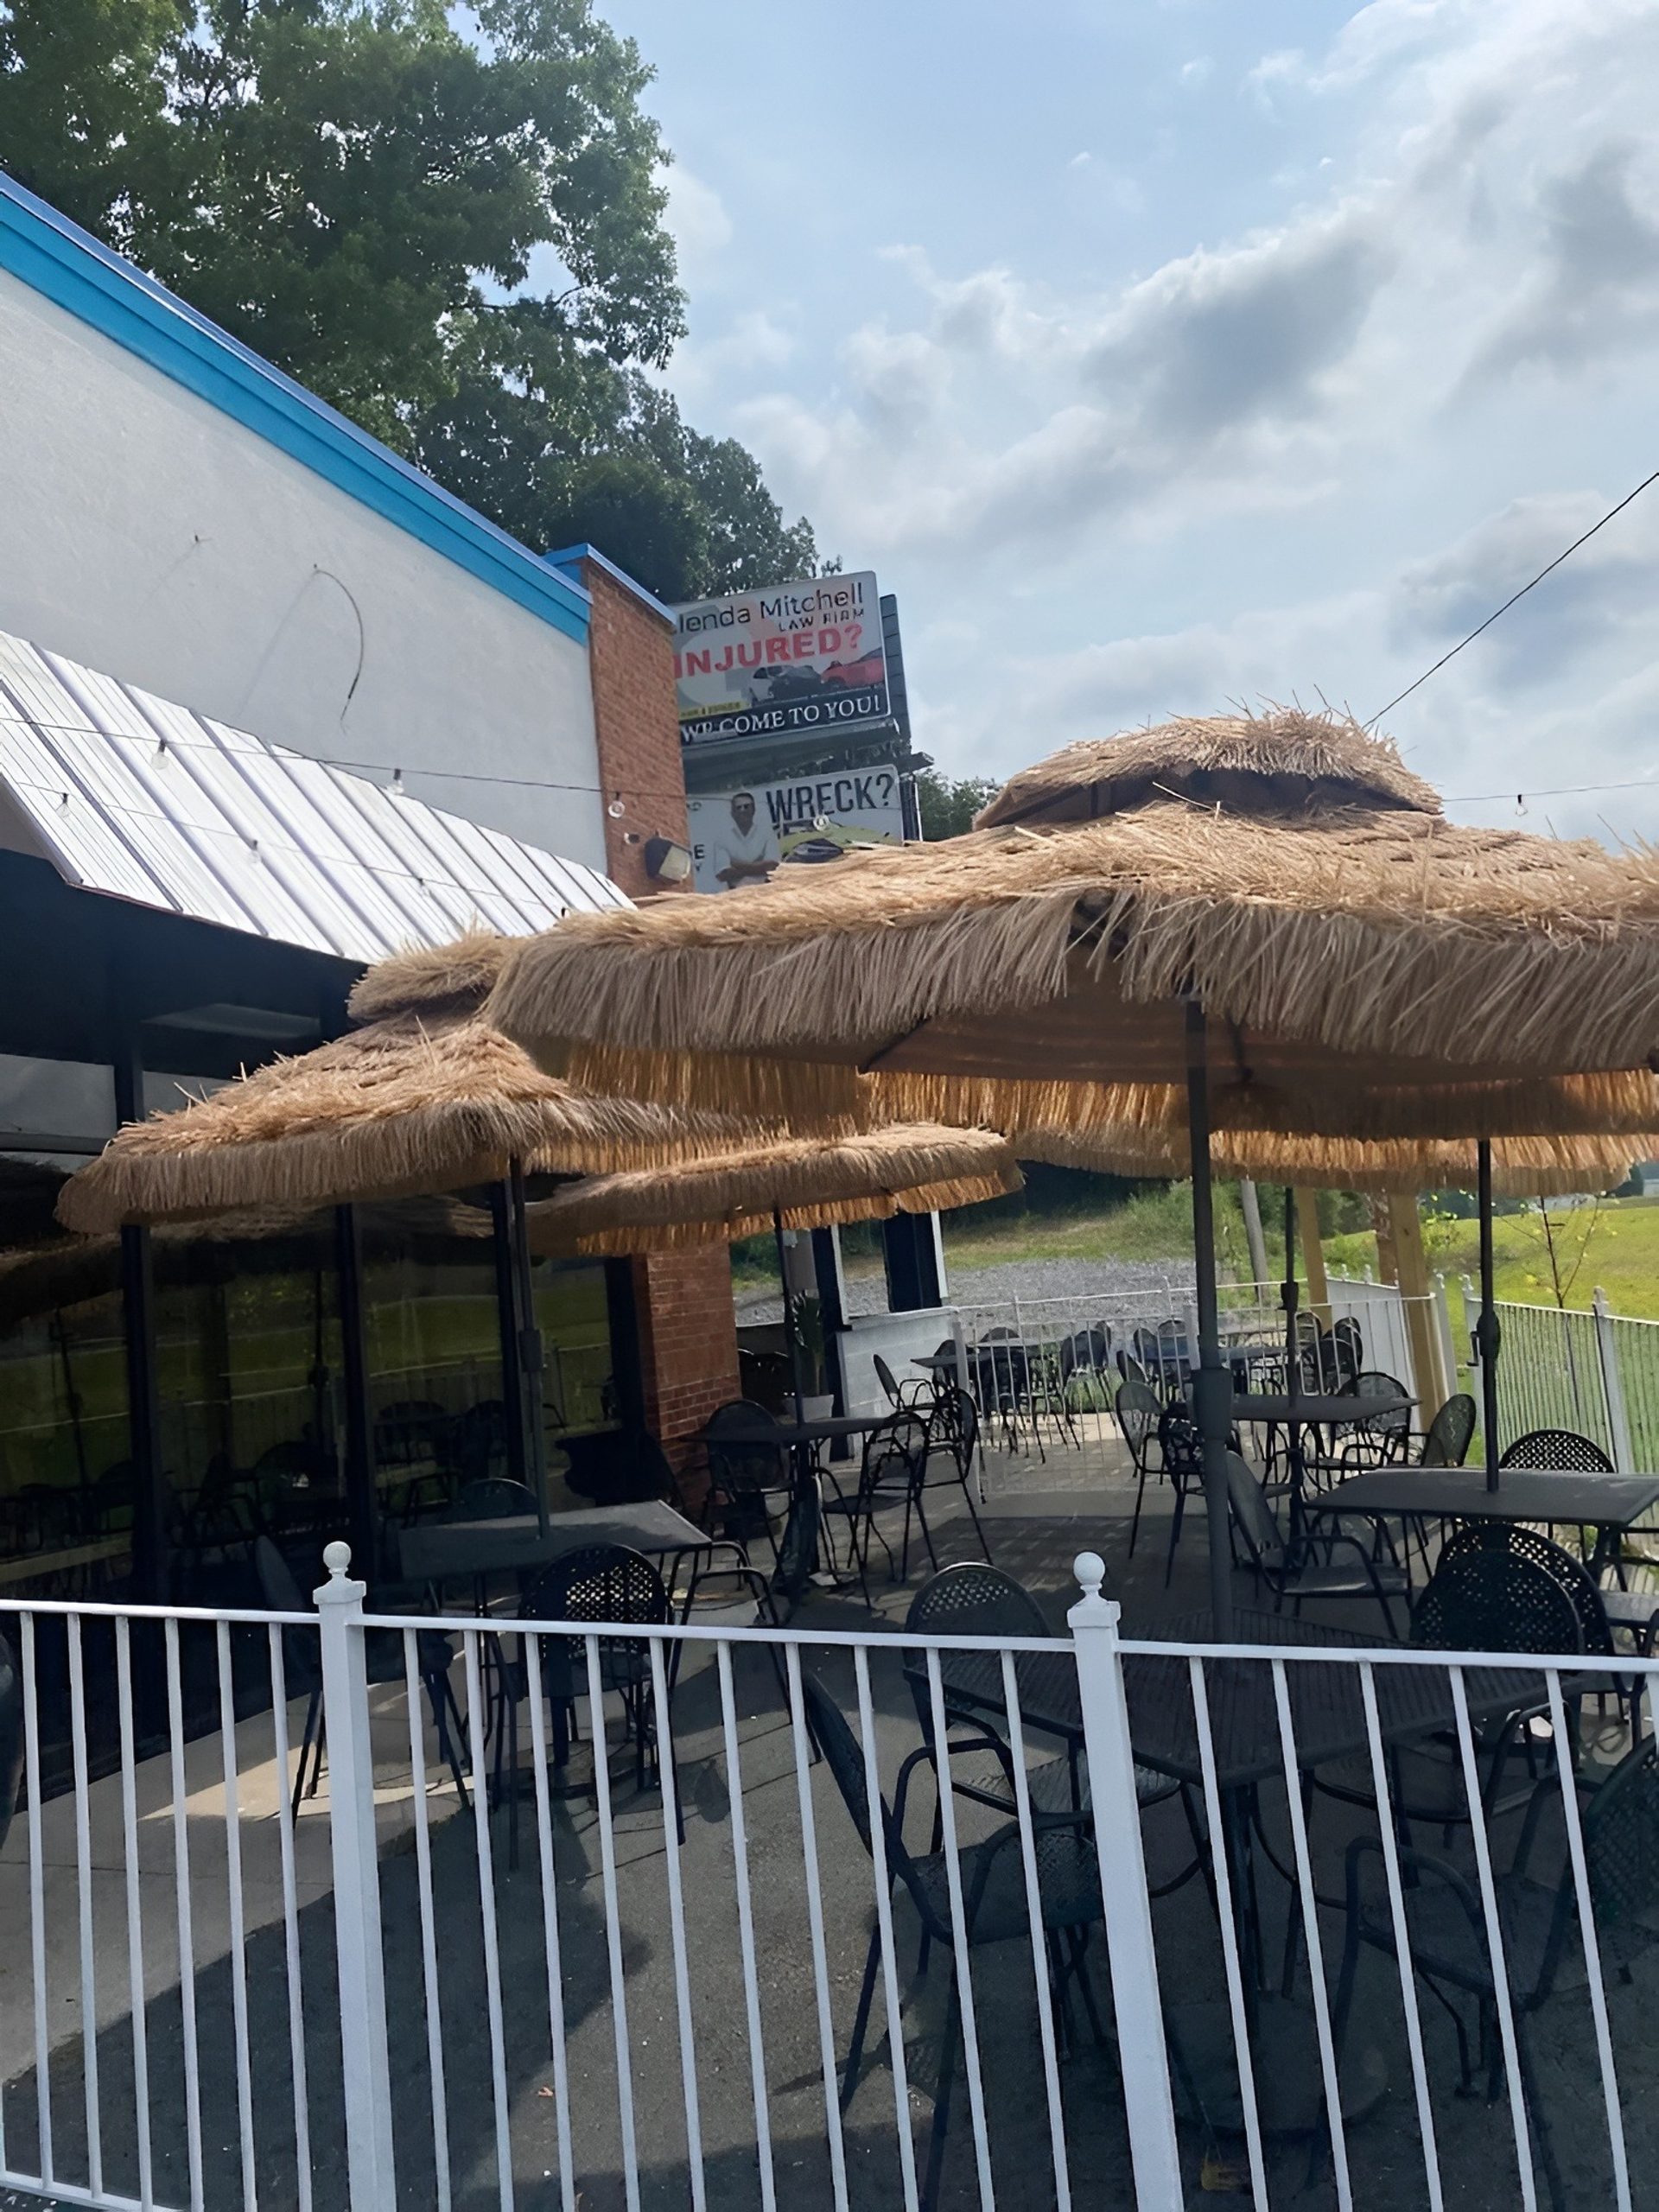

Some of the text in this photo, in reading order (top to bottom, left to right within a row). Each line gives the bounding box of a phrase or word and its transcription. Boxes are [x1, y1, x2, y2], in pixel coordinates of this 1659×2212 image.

[760, 582, 862, 619] Mitchell
[779, 616, 813, 632] LAW
[672, 623, 862, 679] INJURED?
[788, 706, 820, 724] TO
[824, 695, 880, 719] YOU!
[766, 773, 893, 823] WRECK?
